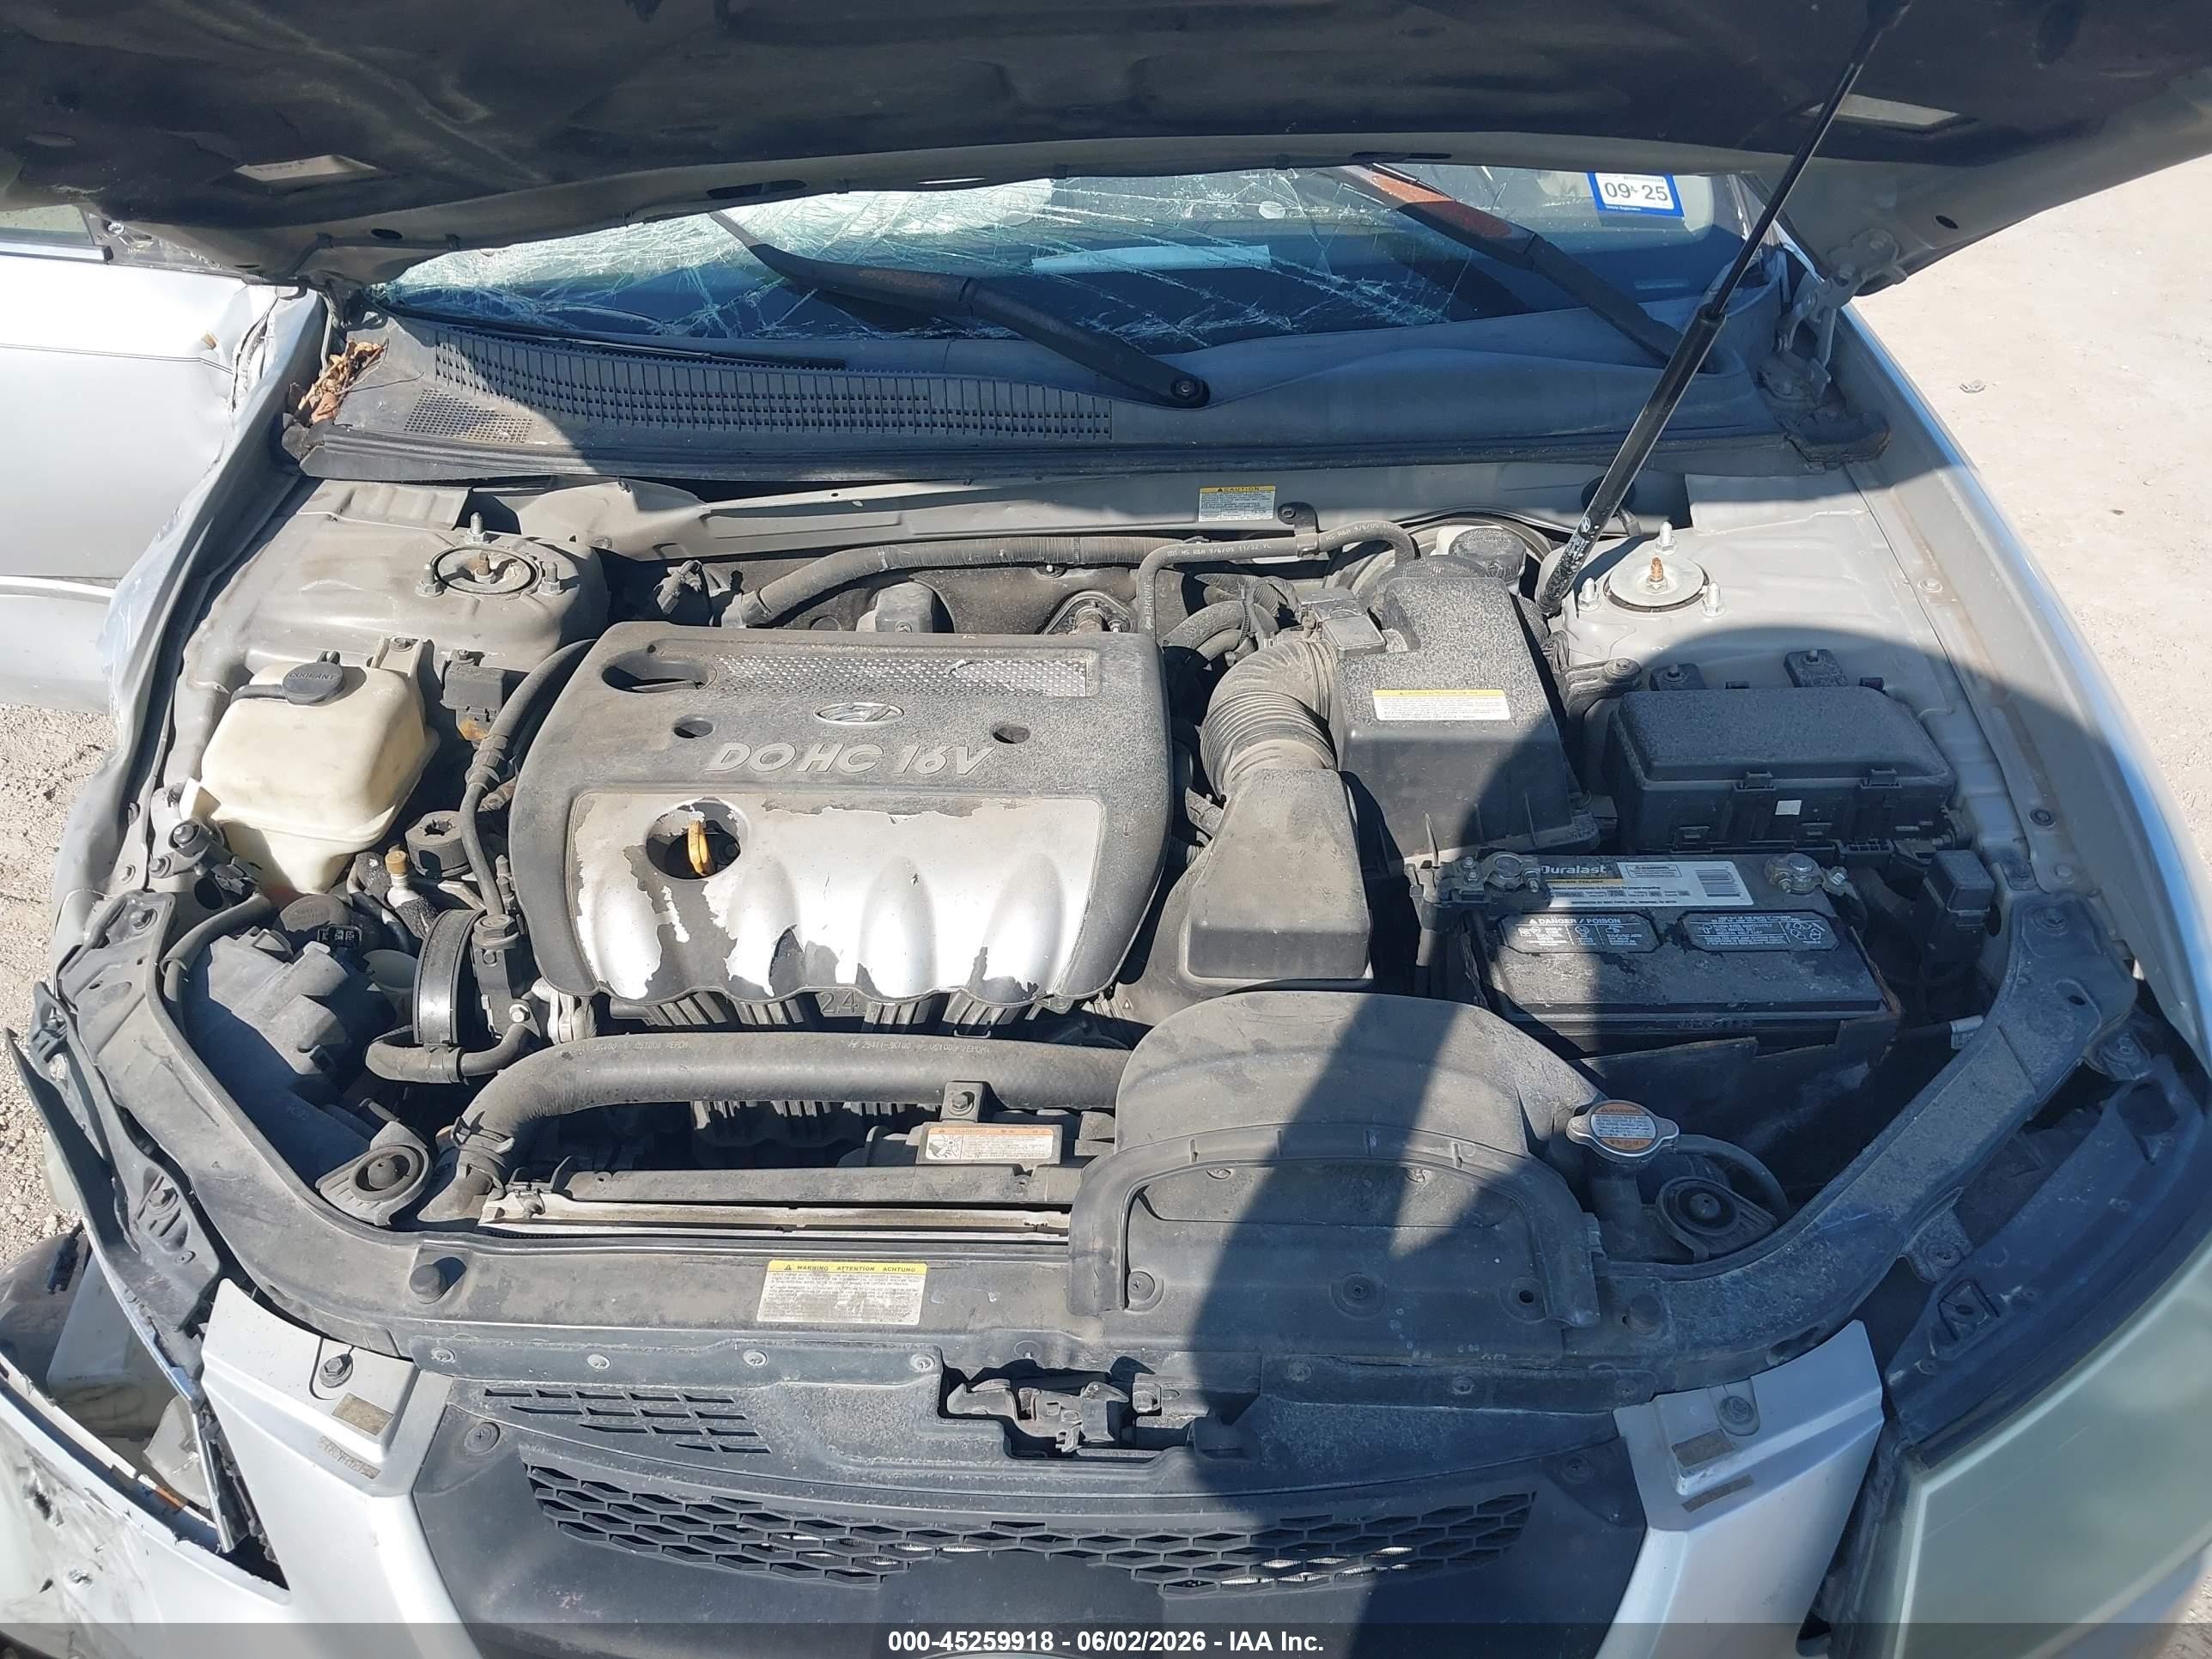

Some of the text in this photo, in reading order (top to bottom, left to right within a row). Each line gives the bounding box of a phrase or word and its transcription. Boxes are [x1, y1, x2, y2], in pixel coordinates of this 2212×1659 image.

[1604, 182, 1668, 201] 09 25
[288, 672, 336, 681] COOLANT
[897, 744, 997, 775] 16V
[1540, 865, 1607, 874] Duralast
[818, 990, 859, 1014] 2.4
